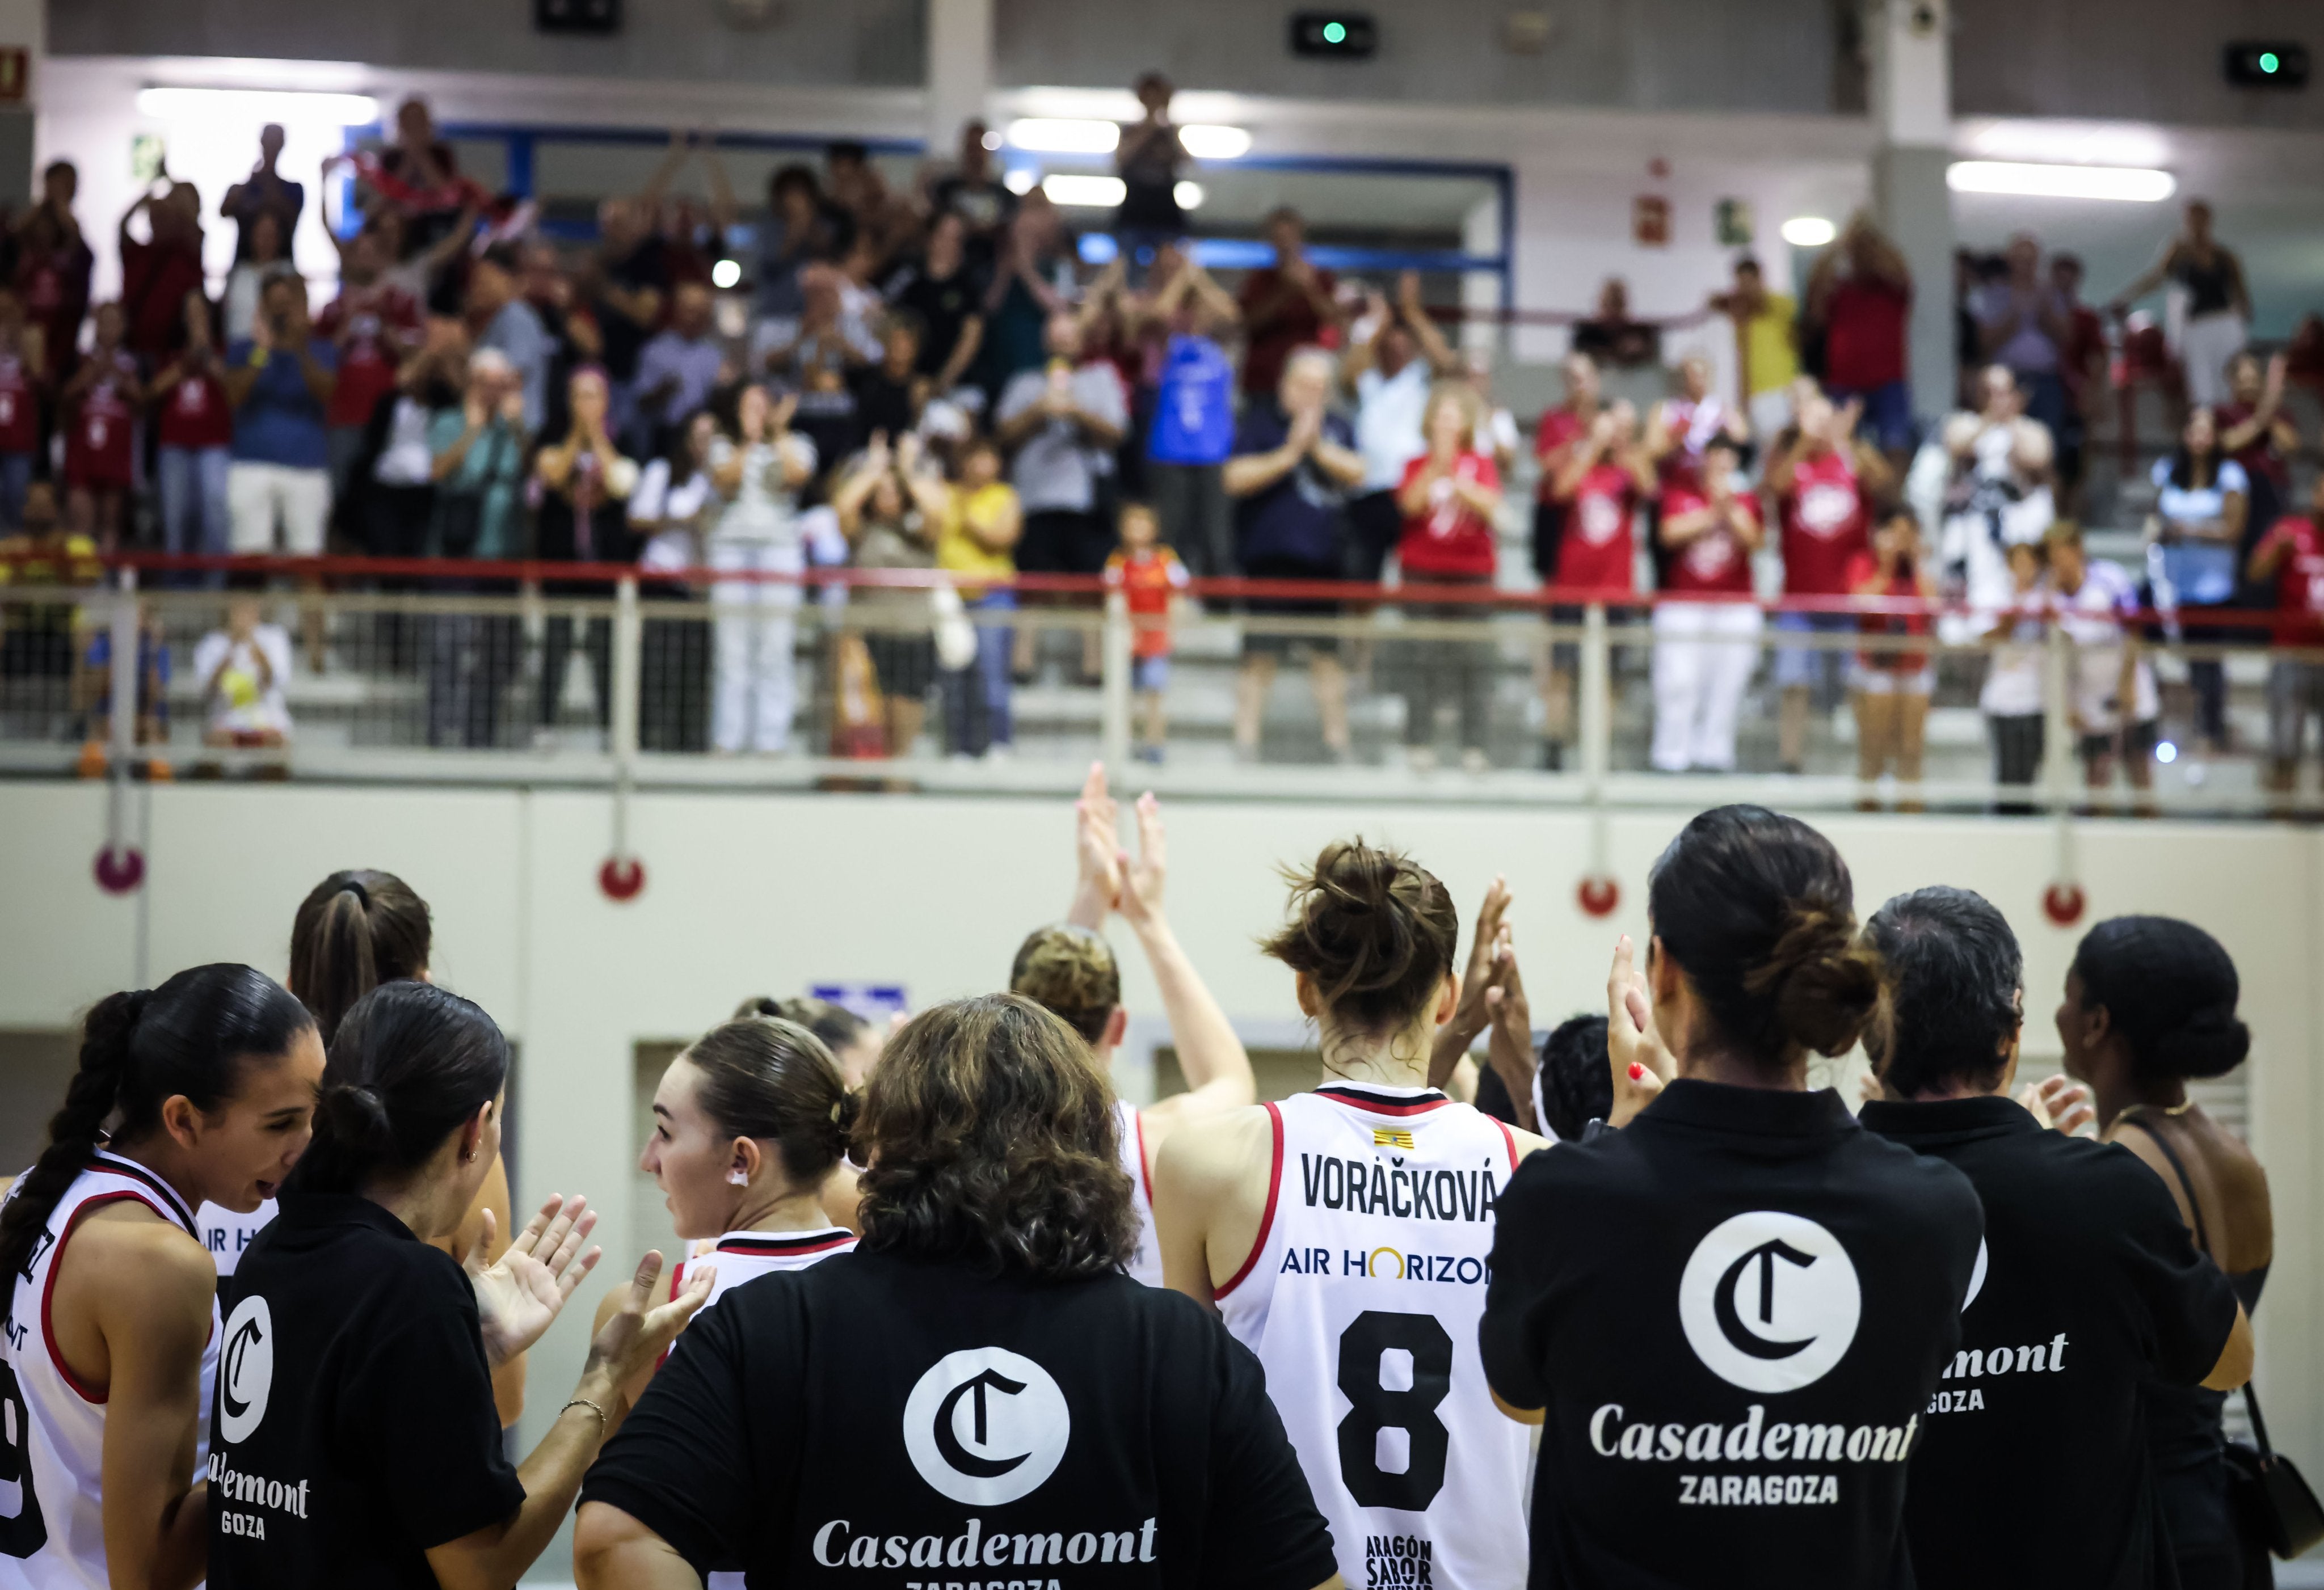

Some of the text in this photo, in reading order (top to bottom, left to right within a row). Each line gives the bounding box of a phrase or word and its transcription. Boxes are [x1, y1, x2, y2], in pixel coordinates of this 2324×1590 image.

[1302, 1153, 1497, 1222] VORÁČKOVÁ
[203, 1228, 226, 1251] IR
[1280, 1248, 1330, 1275] AIR
[1337, 1311, 1452, 1511] 8
[1590, 1404, 1918, 1462] Casademont
[1679, 1475, 1838, 1505] ZARAGOZA
[814, 1517, 1157, 1568] Casademont
[1366, 1535, 1432, 1561] ARAGÓN
[1366, 1558, 1433, 1586] SABOR
